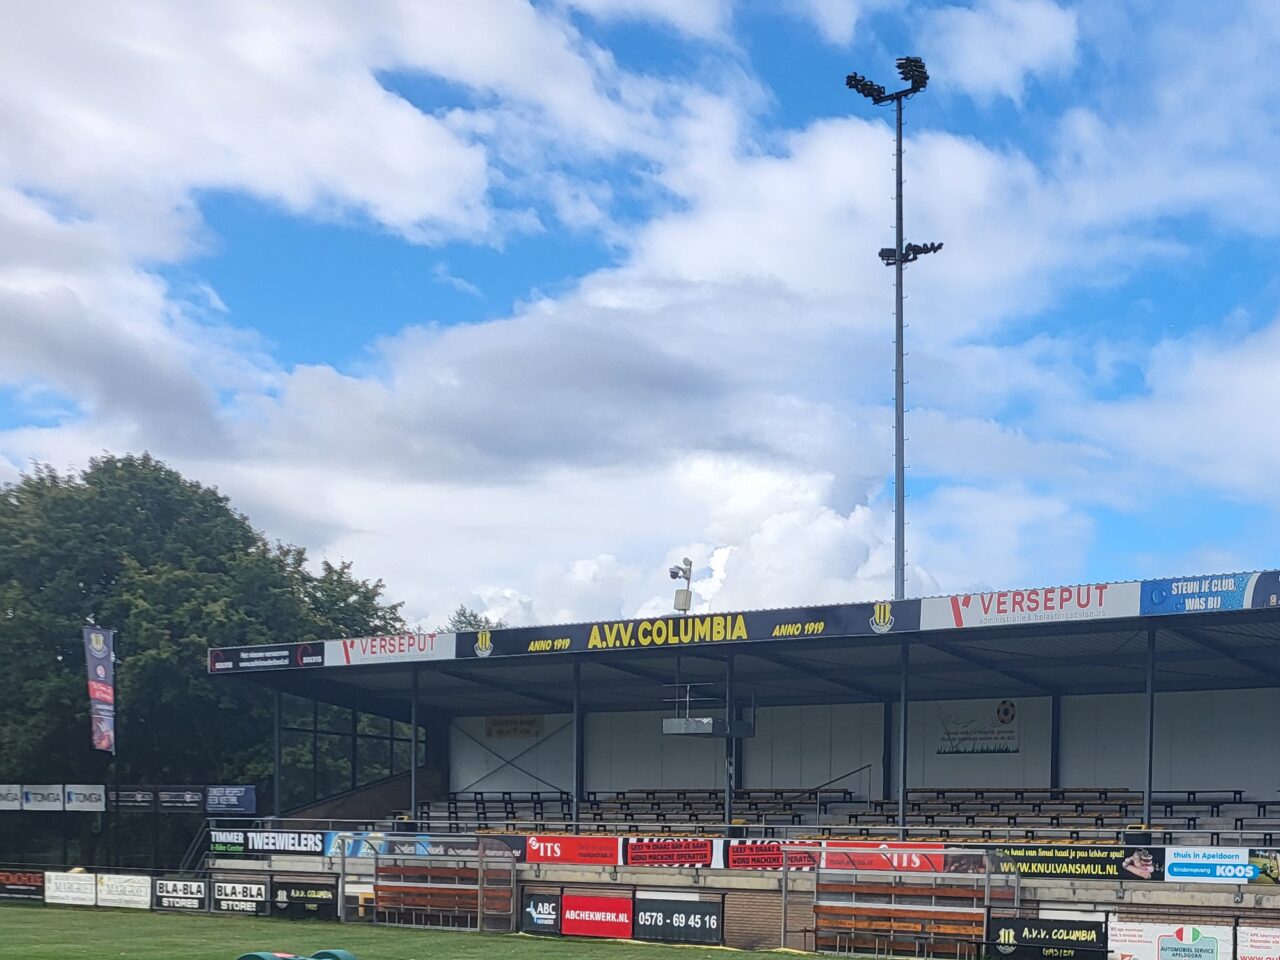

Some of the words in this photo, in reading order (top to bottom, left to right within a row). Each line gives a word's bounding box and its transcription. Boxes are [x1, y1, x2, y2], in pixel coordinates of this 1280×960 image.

[1171, 581, 1199, 595] STEUN
[1201, 580, 1210, 593] JE
[981, 585, 1107, 615] VERSEPUT
[1185, 597, 1205, 610] WAS
[1207, 596, 1221, 609] BIJ
[588, 622, 635, 648] A.V.V.
[638, 614, 747, 646] COLUMBIA
[771, 623, 801, 637] ANNO
[804, 621, 825, 635] 1919
[360, 633, 436, 655] VERSEPUT
[528, 640, 551, 651] ANNO
[553, 638, 571, 650] 1919
[210, 831, 244, 844] TIMMER
[247, 832, 322, 852] TWEEWIELERS
[539, 843, 560, 857] ITS
[1010, 849, 1025, 857] knul
[1038, 849, 1053, 857] Smul
[1054, 849, 1069, 857] haal
[1070, 850, 1076, 859] je
[1077, 850, 1088, 858] pas
[1174, 851, 1192, 860] thuis
[1193, 851, 1200, 859] in
[1202, 851, 1240, 861] Apeldoorn
[1000, 862, 1118, 875] WWW.KNULVANSMUL.NL
[1173, 866, 1211, 875] kinderopvang
[1216, 865, 1254, 877] KOOS
[158, 882, 203, 896] BLA-BLA
[217, 885, 263, 899] BLA-BLA
[162, 899, 199, 908] STORES
[537, 902, 556, 915] ABC
[565, 910, 629, 923] ABCHEKWERK.NL
[638, 911, 663, 926] 0578
[673, 913, 685, 927] 69
[688, 914, 701, 928] 45
[704, 915, 717, 929] 16
[1022, 927, 1049, 940] A.V.V.
[1052, 929, 1097, 942] COLUMBIA
